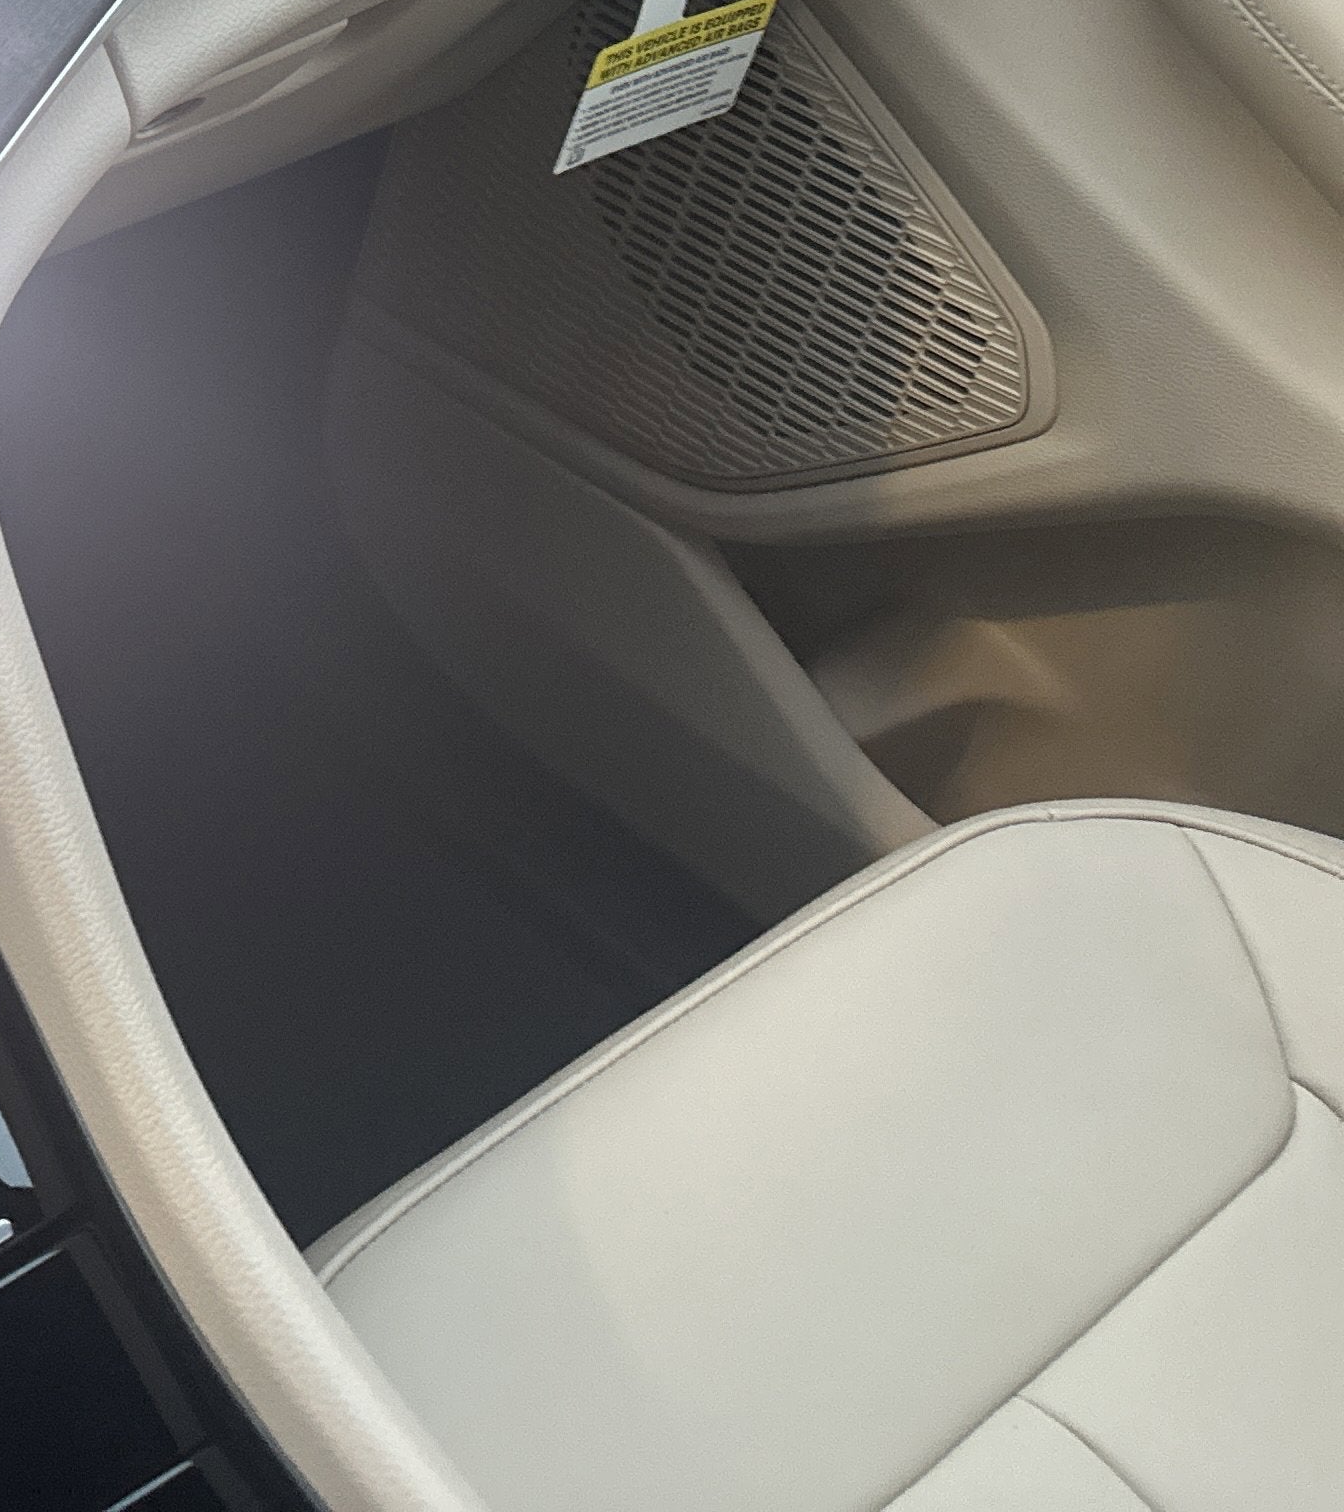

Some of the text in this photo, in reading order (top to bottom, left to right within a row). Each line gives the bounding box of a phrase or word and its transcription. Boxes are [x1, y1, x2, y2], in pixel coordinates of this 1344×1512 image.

[600, 15, 762, 80] WITH ADVANCED AIR BAGS
[606, 1, 768, 65] THIS VEHICLE IS EQUIPPED
